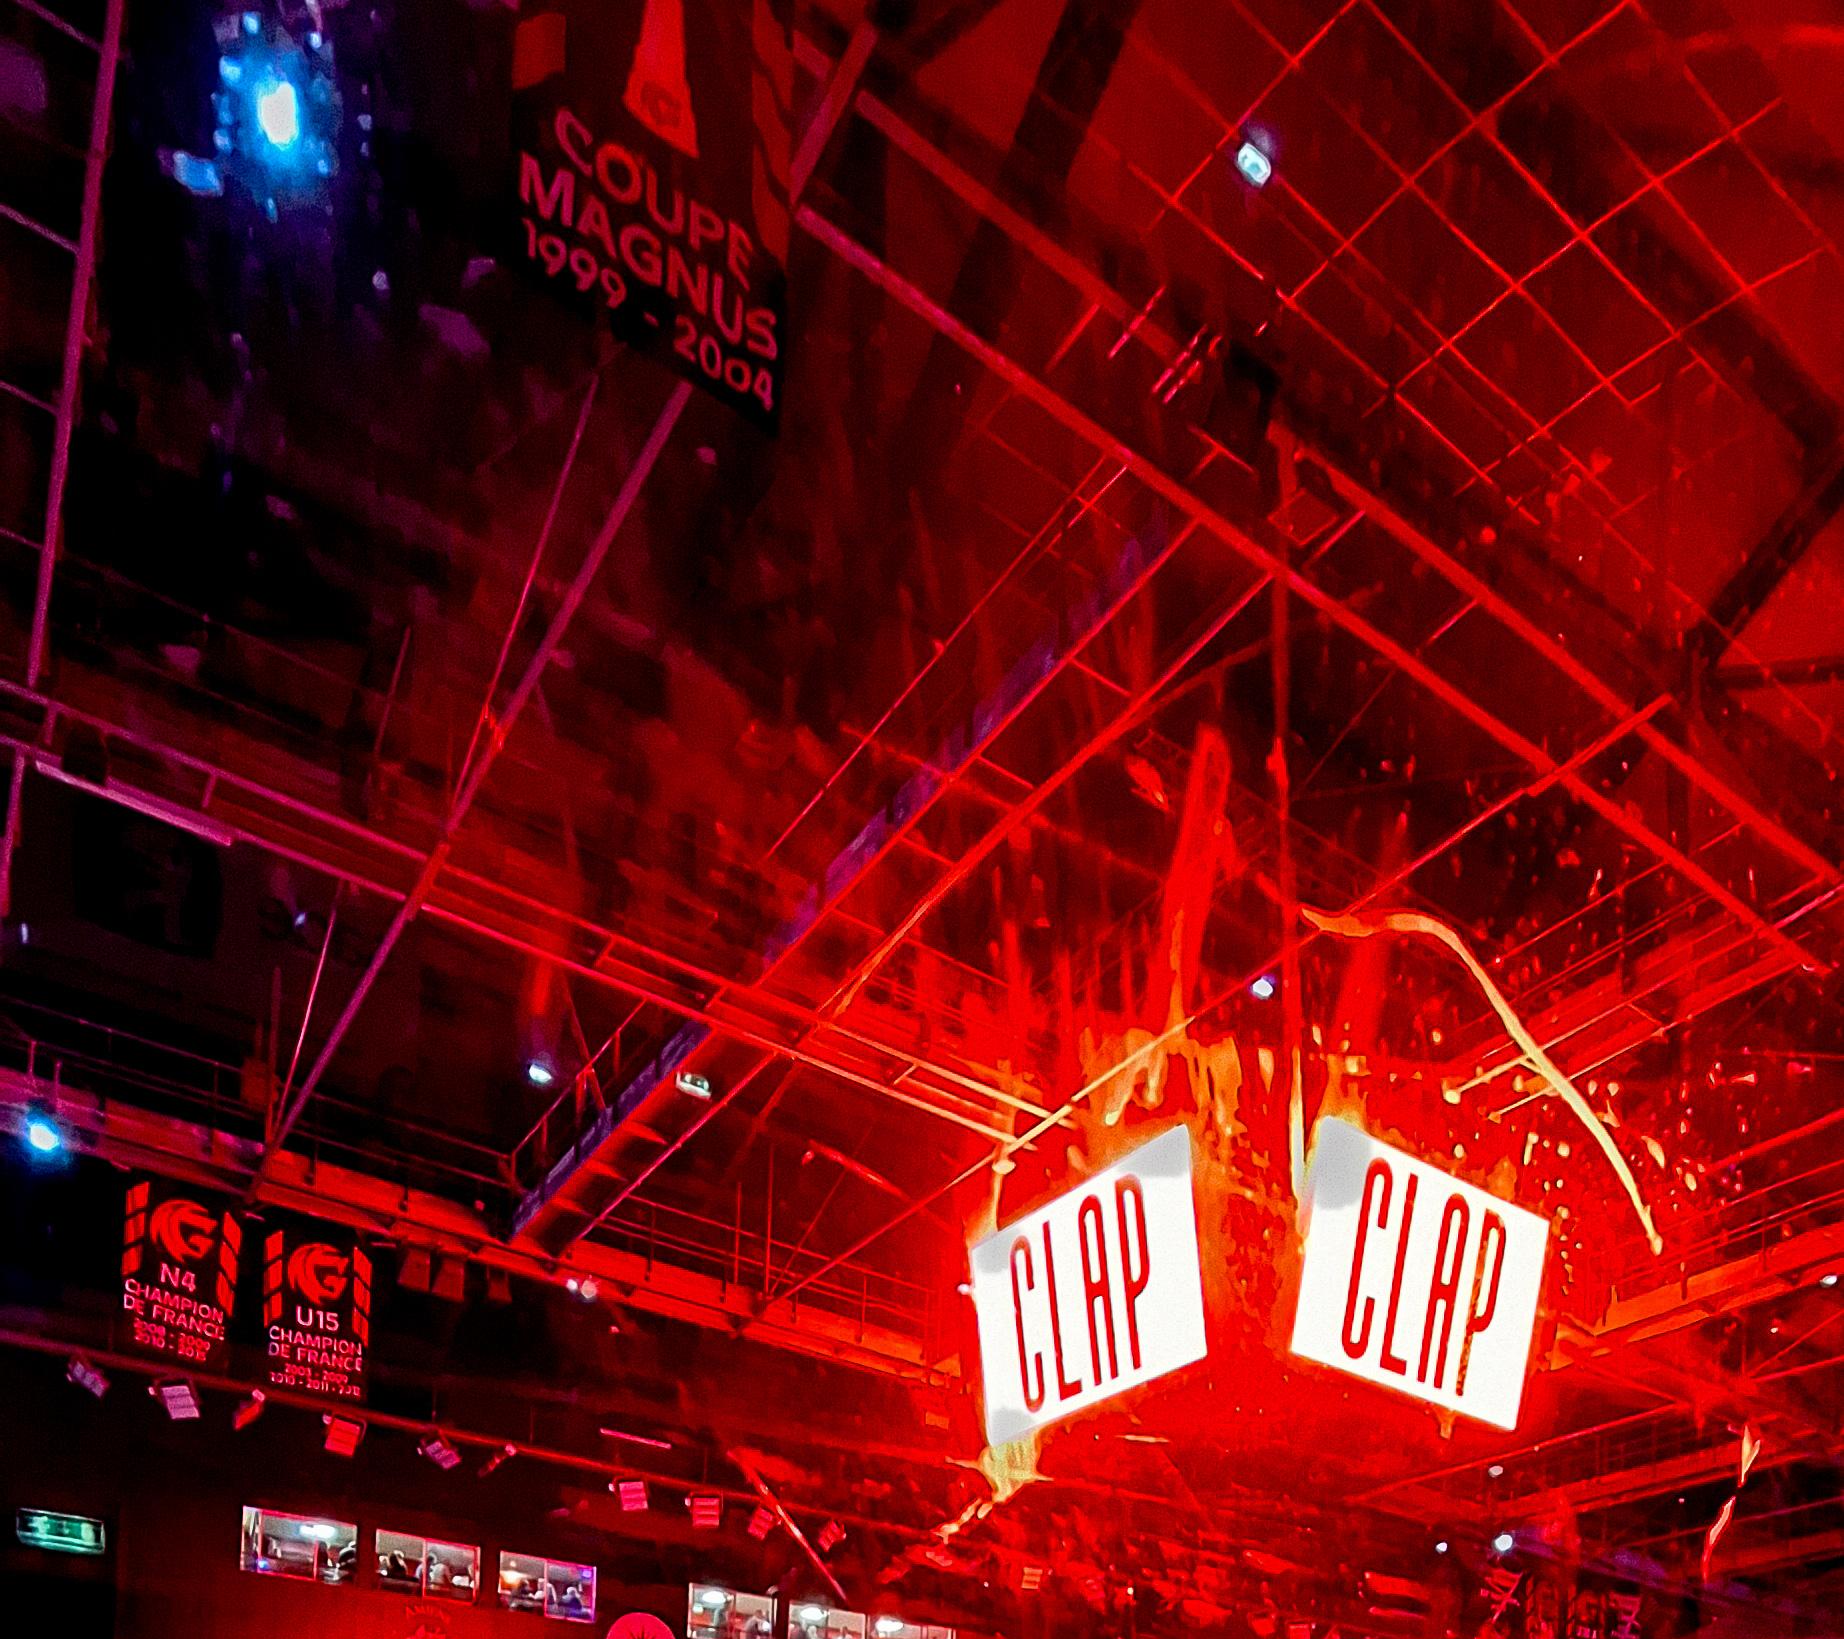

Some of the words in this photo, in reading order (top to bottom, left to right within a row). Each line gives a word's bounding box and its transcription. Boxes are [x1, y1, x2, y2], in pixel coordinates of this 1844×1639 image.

[554, 108, 754, 292] COUPE
[519, 151, 778, 361] MAGNUS
[521, 216, 627, 309] 1999
[673, 314, 774, 412] 2004
[159, 1262, 196, 1293] N4
[1009, 1173, 1150, 1414] CLAP
[1341, 1156, 1507, 1397] CLAP
[123, 1293, 145, 1316] DE
[152, 1304, 225, 1341] FRANCE
[124, 1278, 224, 1324] CHAMPION
[295, 1305, 340, 1331] U15
[268, 1325, 363, 1356] CHAMPION
[268, 1341, 291, 1359] DE
[296, 1346, 363, 1372] FRANCE
